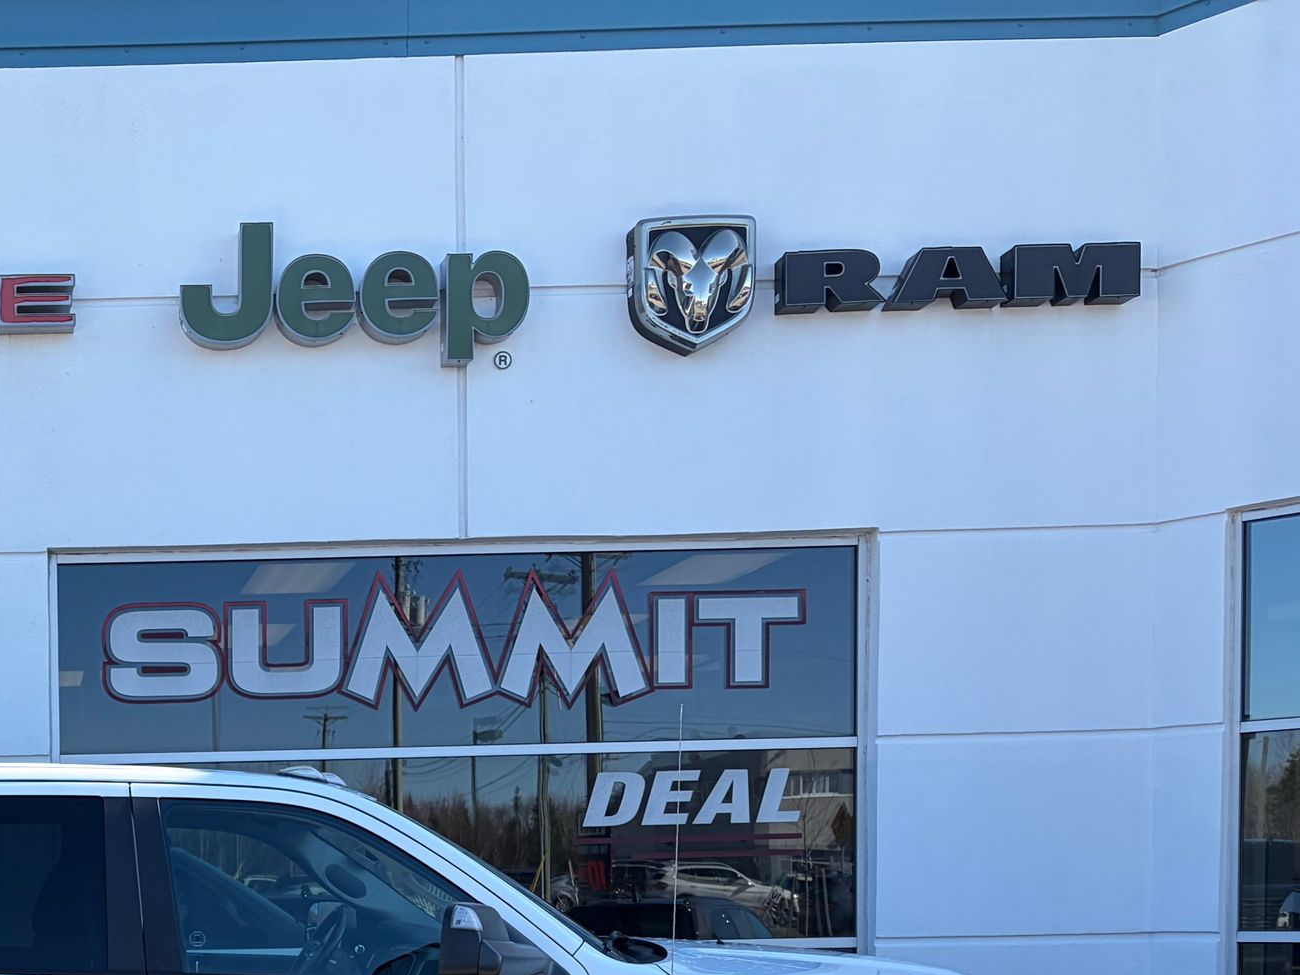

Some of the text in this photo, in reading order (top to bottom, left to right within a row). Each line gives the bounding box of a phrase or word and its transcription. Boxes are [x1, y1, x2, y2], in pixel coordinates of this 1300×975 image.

[179, 221, 530, 367] Jeep
[774, 241, 1141, 315] RAM
[103, 569, 806, 711] SUMMIT
[583, 767, 802, 828] DEAL
